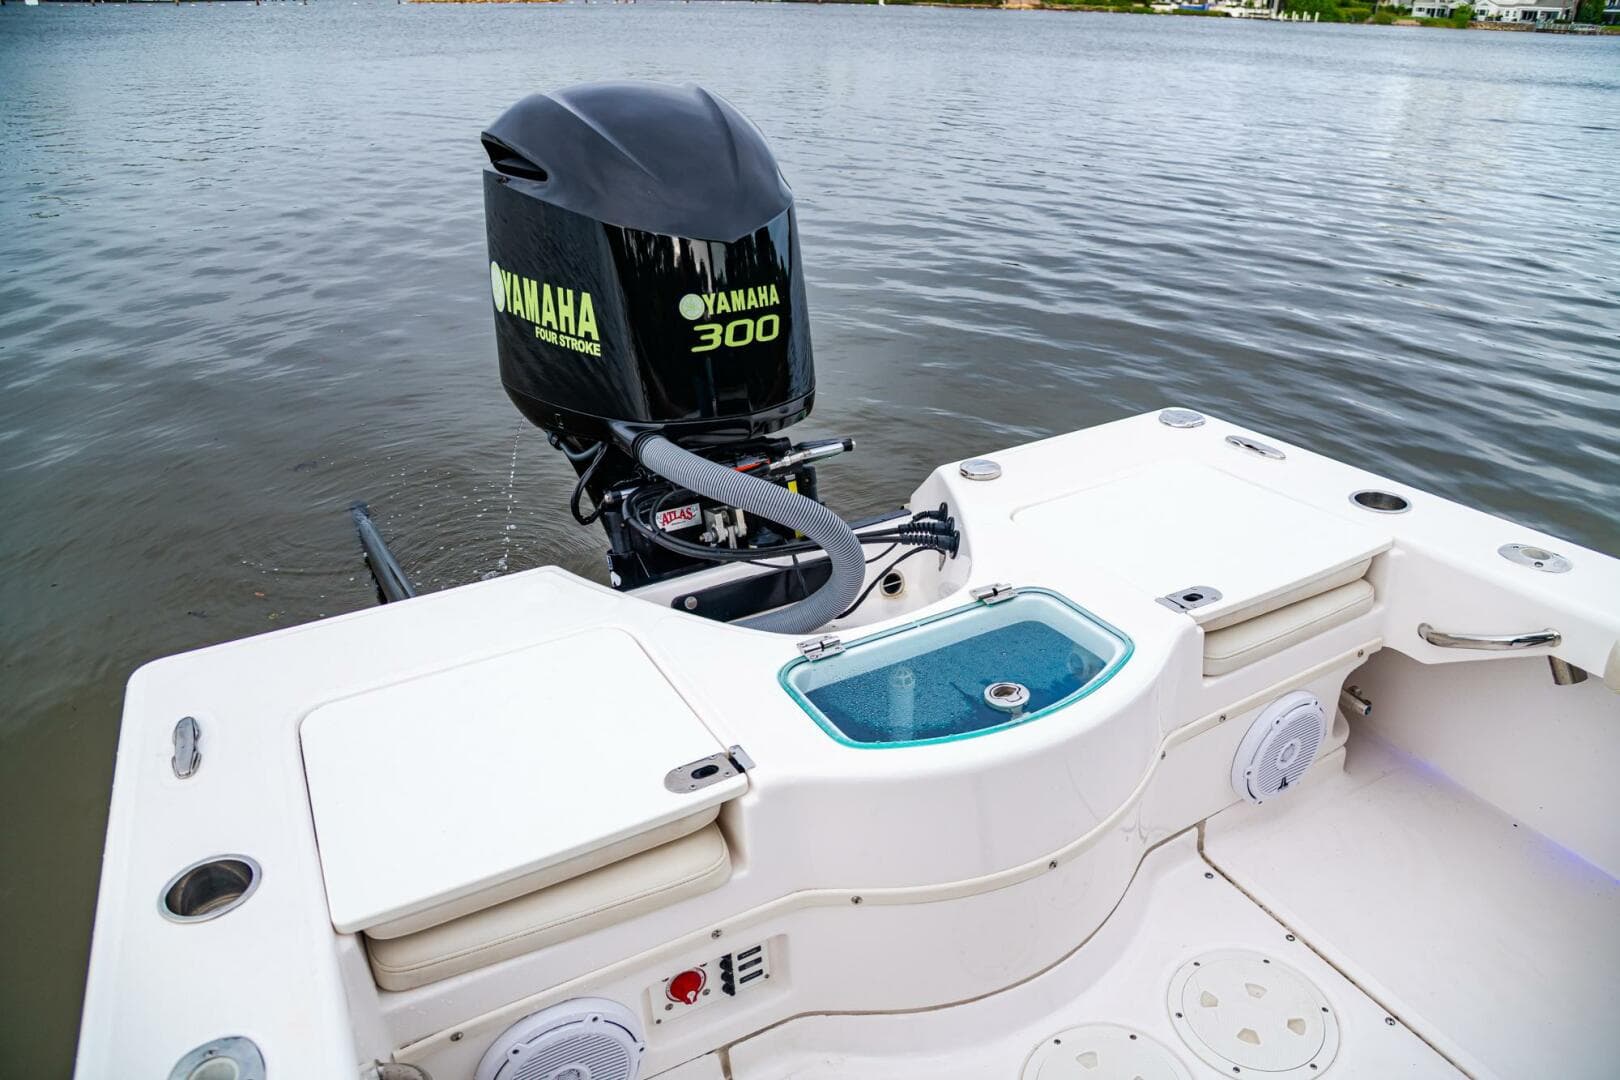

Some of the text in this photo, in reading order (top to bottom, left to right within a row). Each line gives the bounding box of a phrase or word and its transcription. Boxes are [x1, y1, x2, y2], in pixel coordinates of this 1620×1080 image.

[501, 269, 600, 341] YAMAHA
[701, 284, 780, 315] YAMAHA
[535, 326, 601, 357] FOUR STROKE
[691, 314, 780, 353] 300
[662, 507, 693, 526] ATLAS
